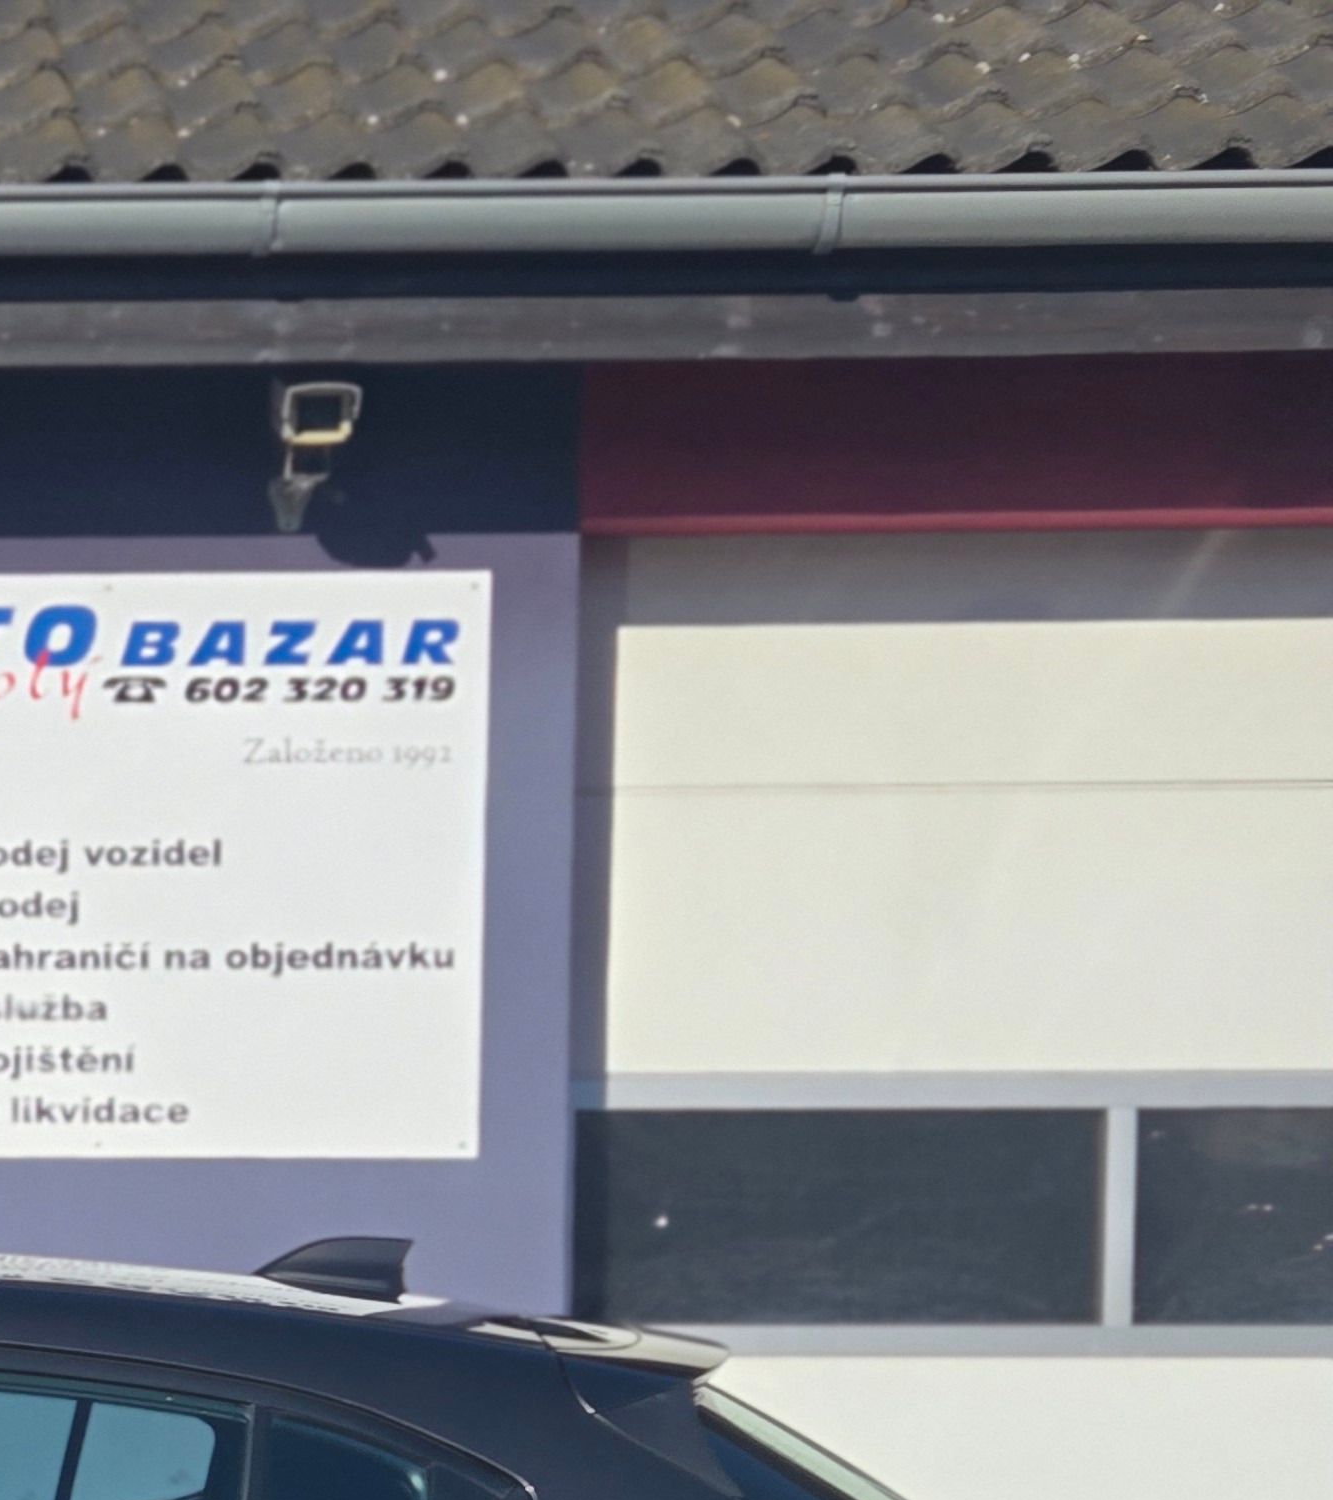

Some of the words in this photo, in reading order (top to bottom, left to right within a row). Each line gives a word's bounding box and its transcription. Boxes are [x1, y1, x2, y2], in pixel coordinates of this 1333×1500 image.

[121, 619, 460, 666] BAZAR
[185, 677, 268, 702] 602
[284, 677, 367, 702] 320
[383, 676, 456, 702] 319
[243, 738, 382, 765] Založeno
[84, 839, 222, 867] vozidel
[164, 949, 211, 970] na
[225, 942, 455, 976] objednávku
[11, 1097, 190, 1124] likvidace
